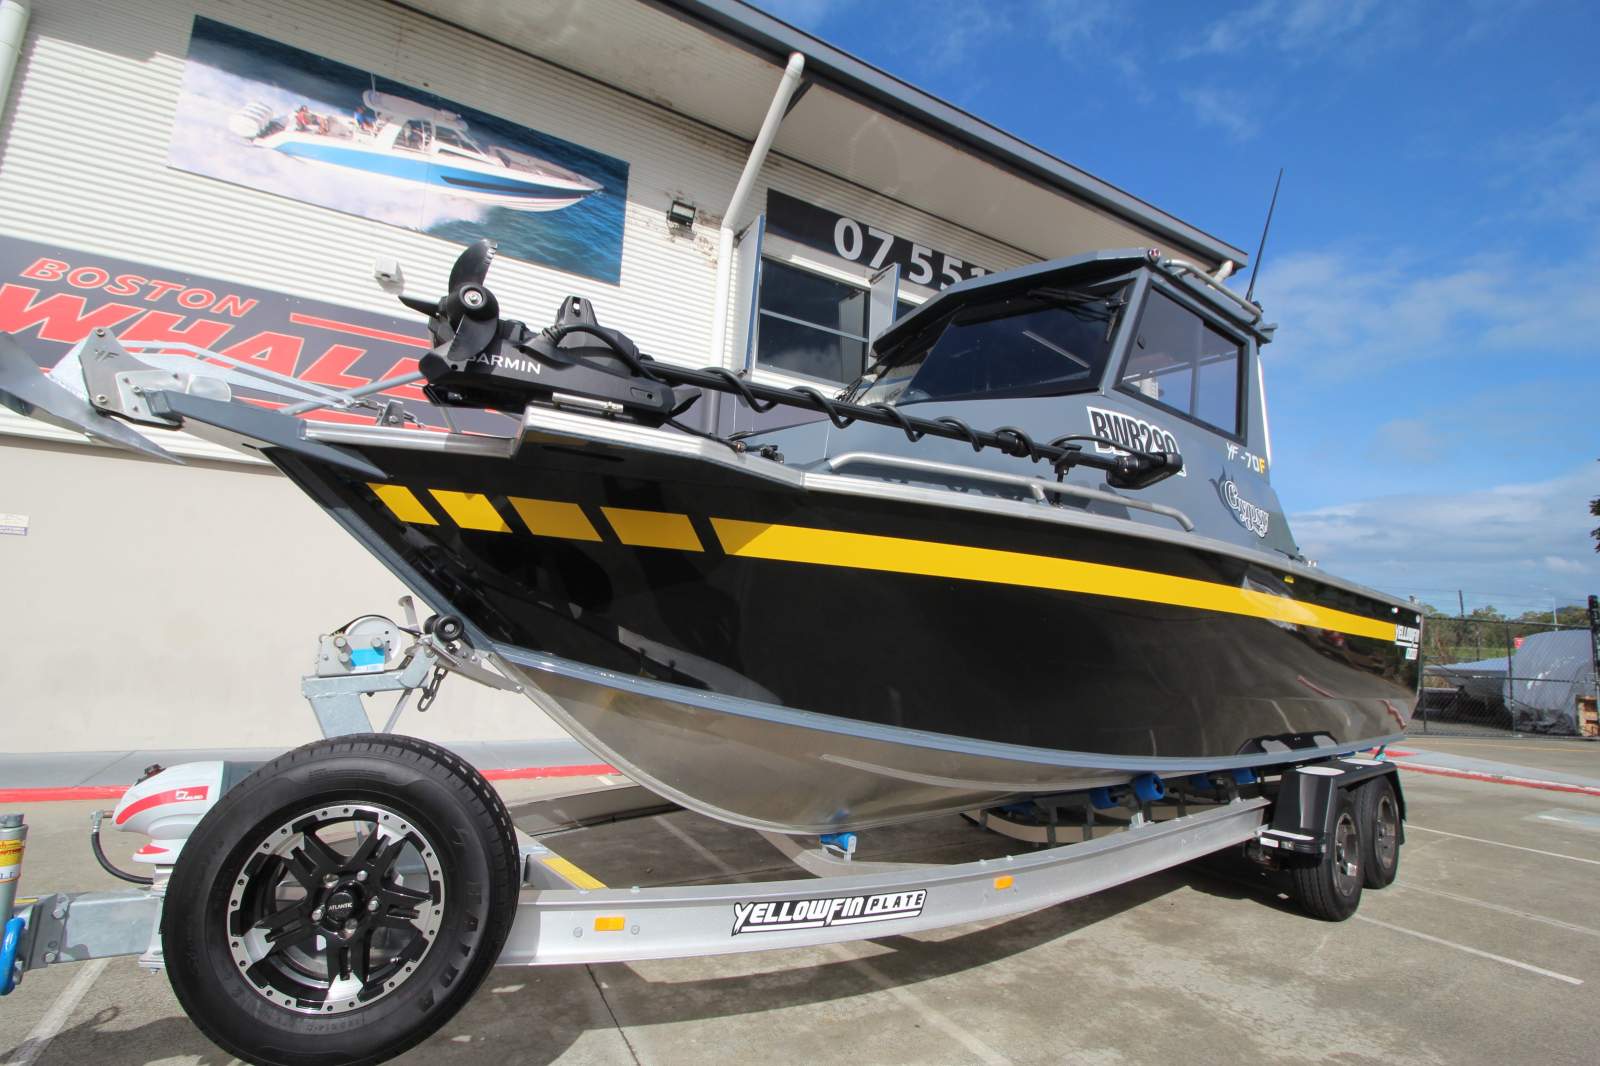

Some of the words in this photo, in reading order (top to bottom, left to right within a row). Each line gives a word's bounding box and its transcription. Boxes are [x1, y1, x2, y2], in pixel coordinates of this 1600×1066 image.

[834, 217, 894, 270] 07
[20, 257, 259, 318] BOSTON
[328, 902, 353, 911] ATLANTIC
[732, 895, 866, 937] YELLOWFIN
[868, 891, 925, 912] PLATE
